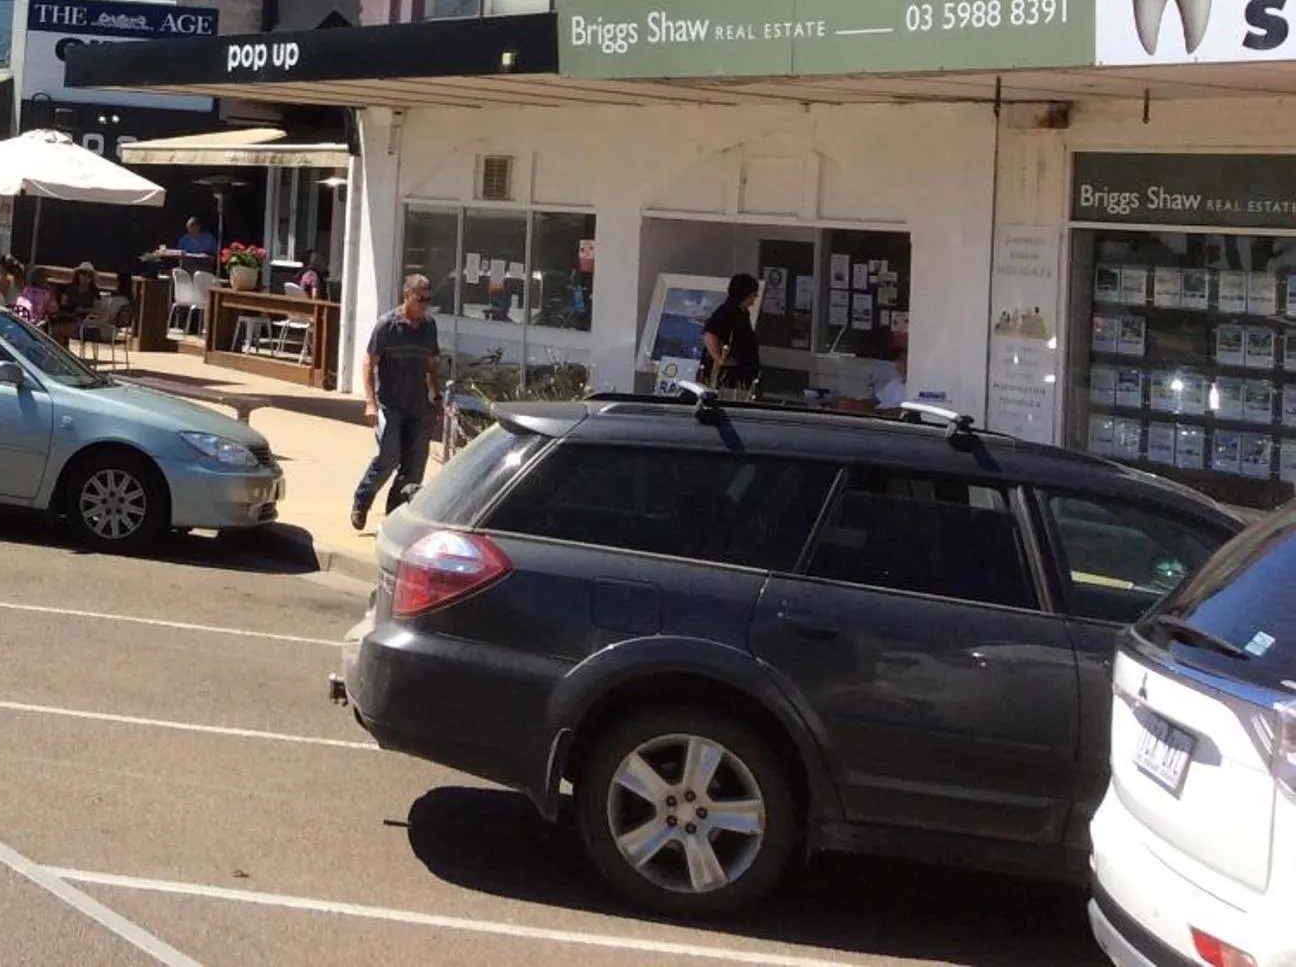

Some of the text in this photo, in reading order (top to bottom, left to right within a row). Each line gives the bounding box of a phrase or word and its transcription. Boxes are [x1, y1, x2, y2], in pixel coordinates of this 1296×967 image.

[34, 4, 88, 26] THE
[159, 14, 213, 35] AGE
[571, 16, 639, 55] Briggs
[647, 11, 709, 45] Shaw
[715, 25, 755, 41] REAL
[764, 20, 827, 38] ESTATE
[906, 2, 933, 31] 03
[228, 41, 300, 72] pop up
[1080, 184, 1140, 215] Briggs
[1147, 185, 1202, 211] Shaw
[1206, 199, 1241, 213] REAL
